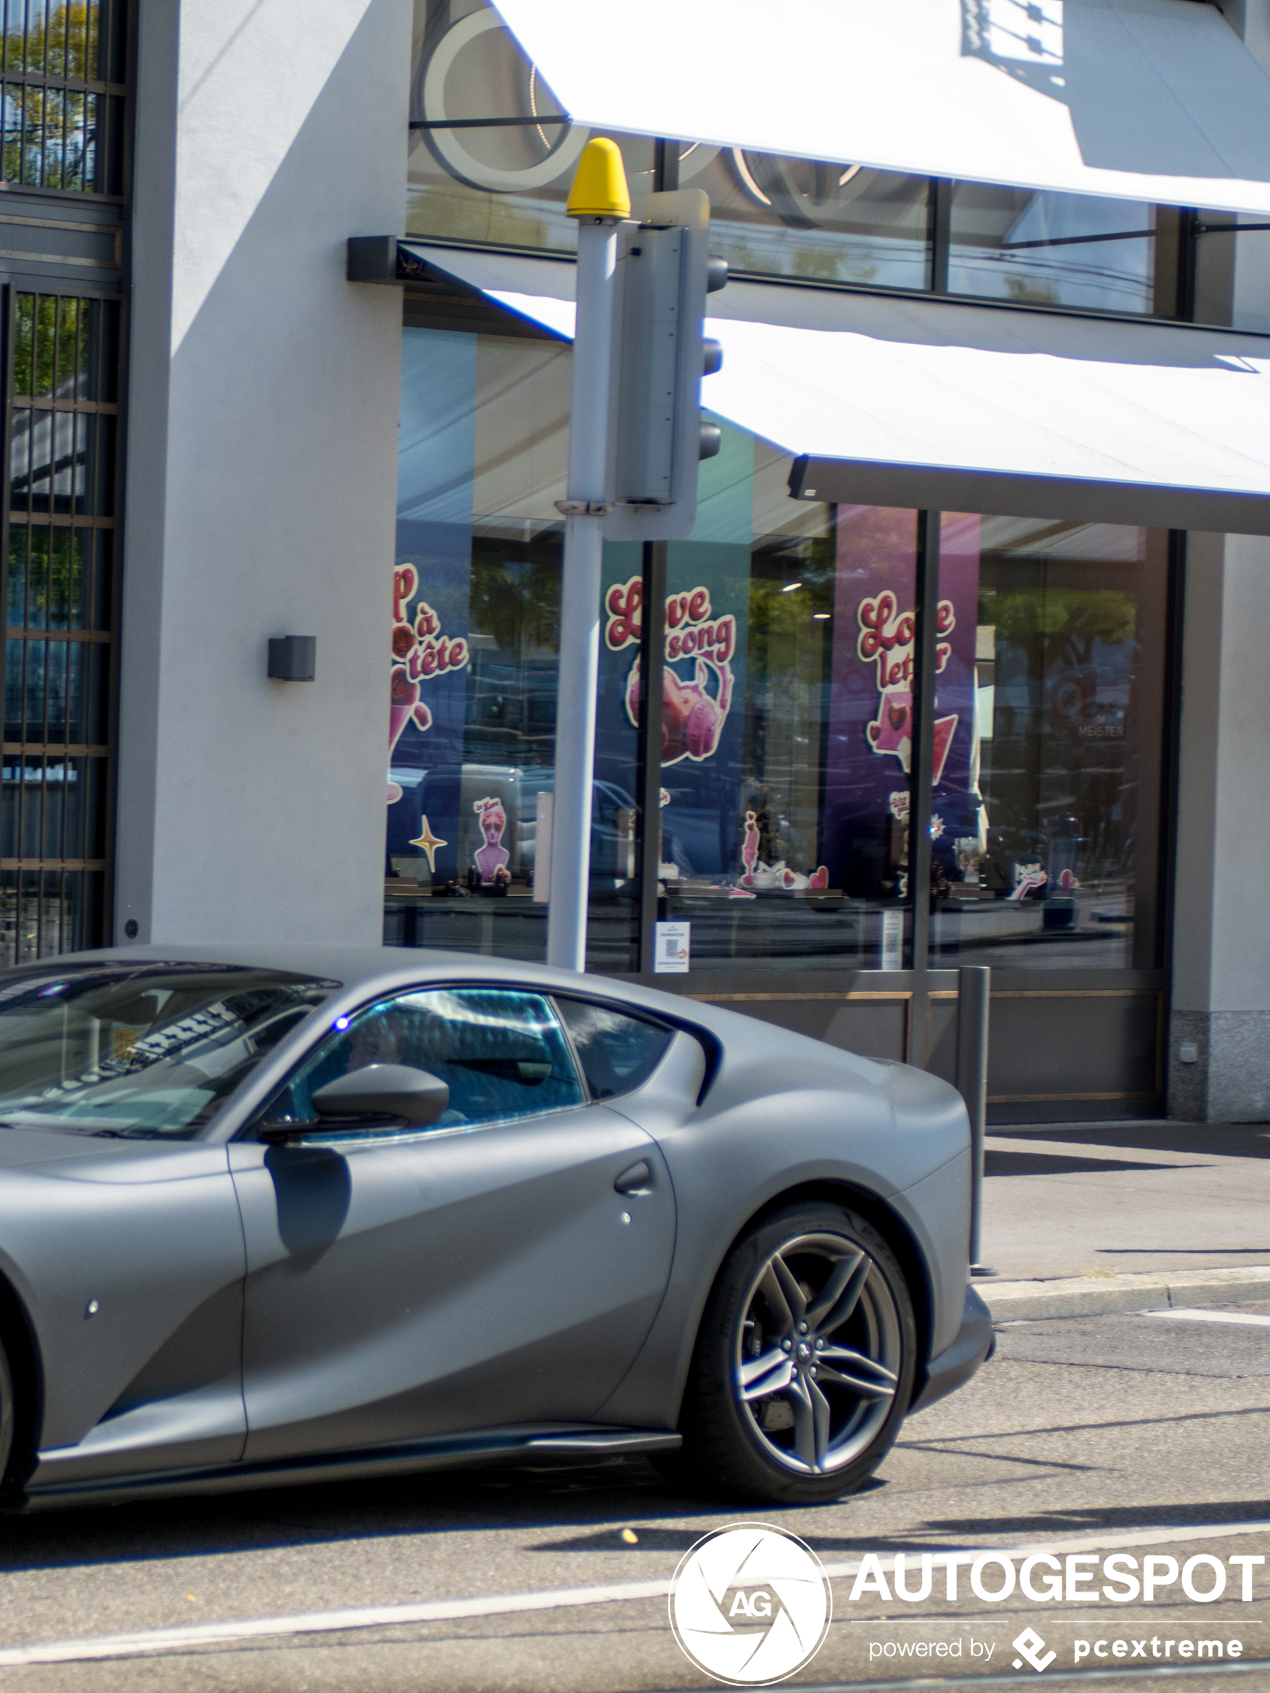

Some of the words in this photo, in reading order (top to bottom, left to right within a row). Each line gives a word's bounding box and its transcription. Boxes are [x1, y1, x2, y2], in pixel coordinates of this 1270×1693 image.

[417, 606, 439, 638] à
[608, 580, 710, 648] Lve
[860, 594, 954, 659] Loe
[409, 639, 467, 679] tête
[668, 618, 734, 663] song
[878, 647, 949, 689] letr
[1078, 725, 1124, 737] MEISTER
